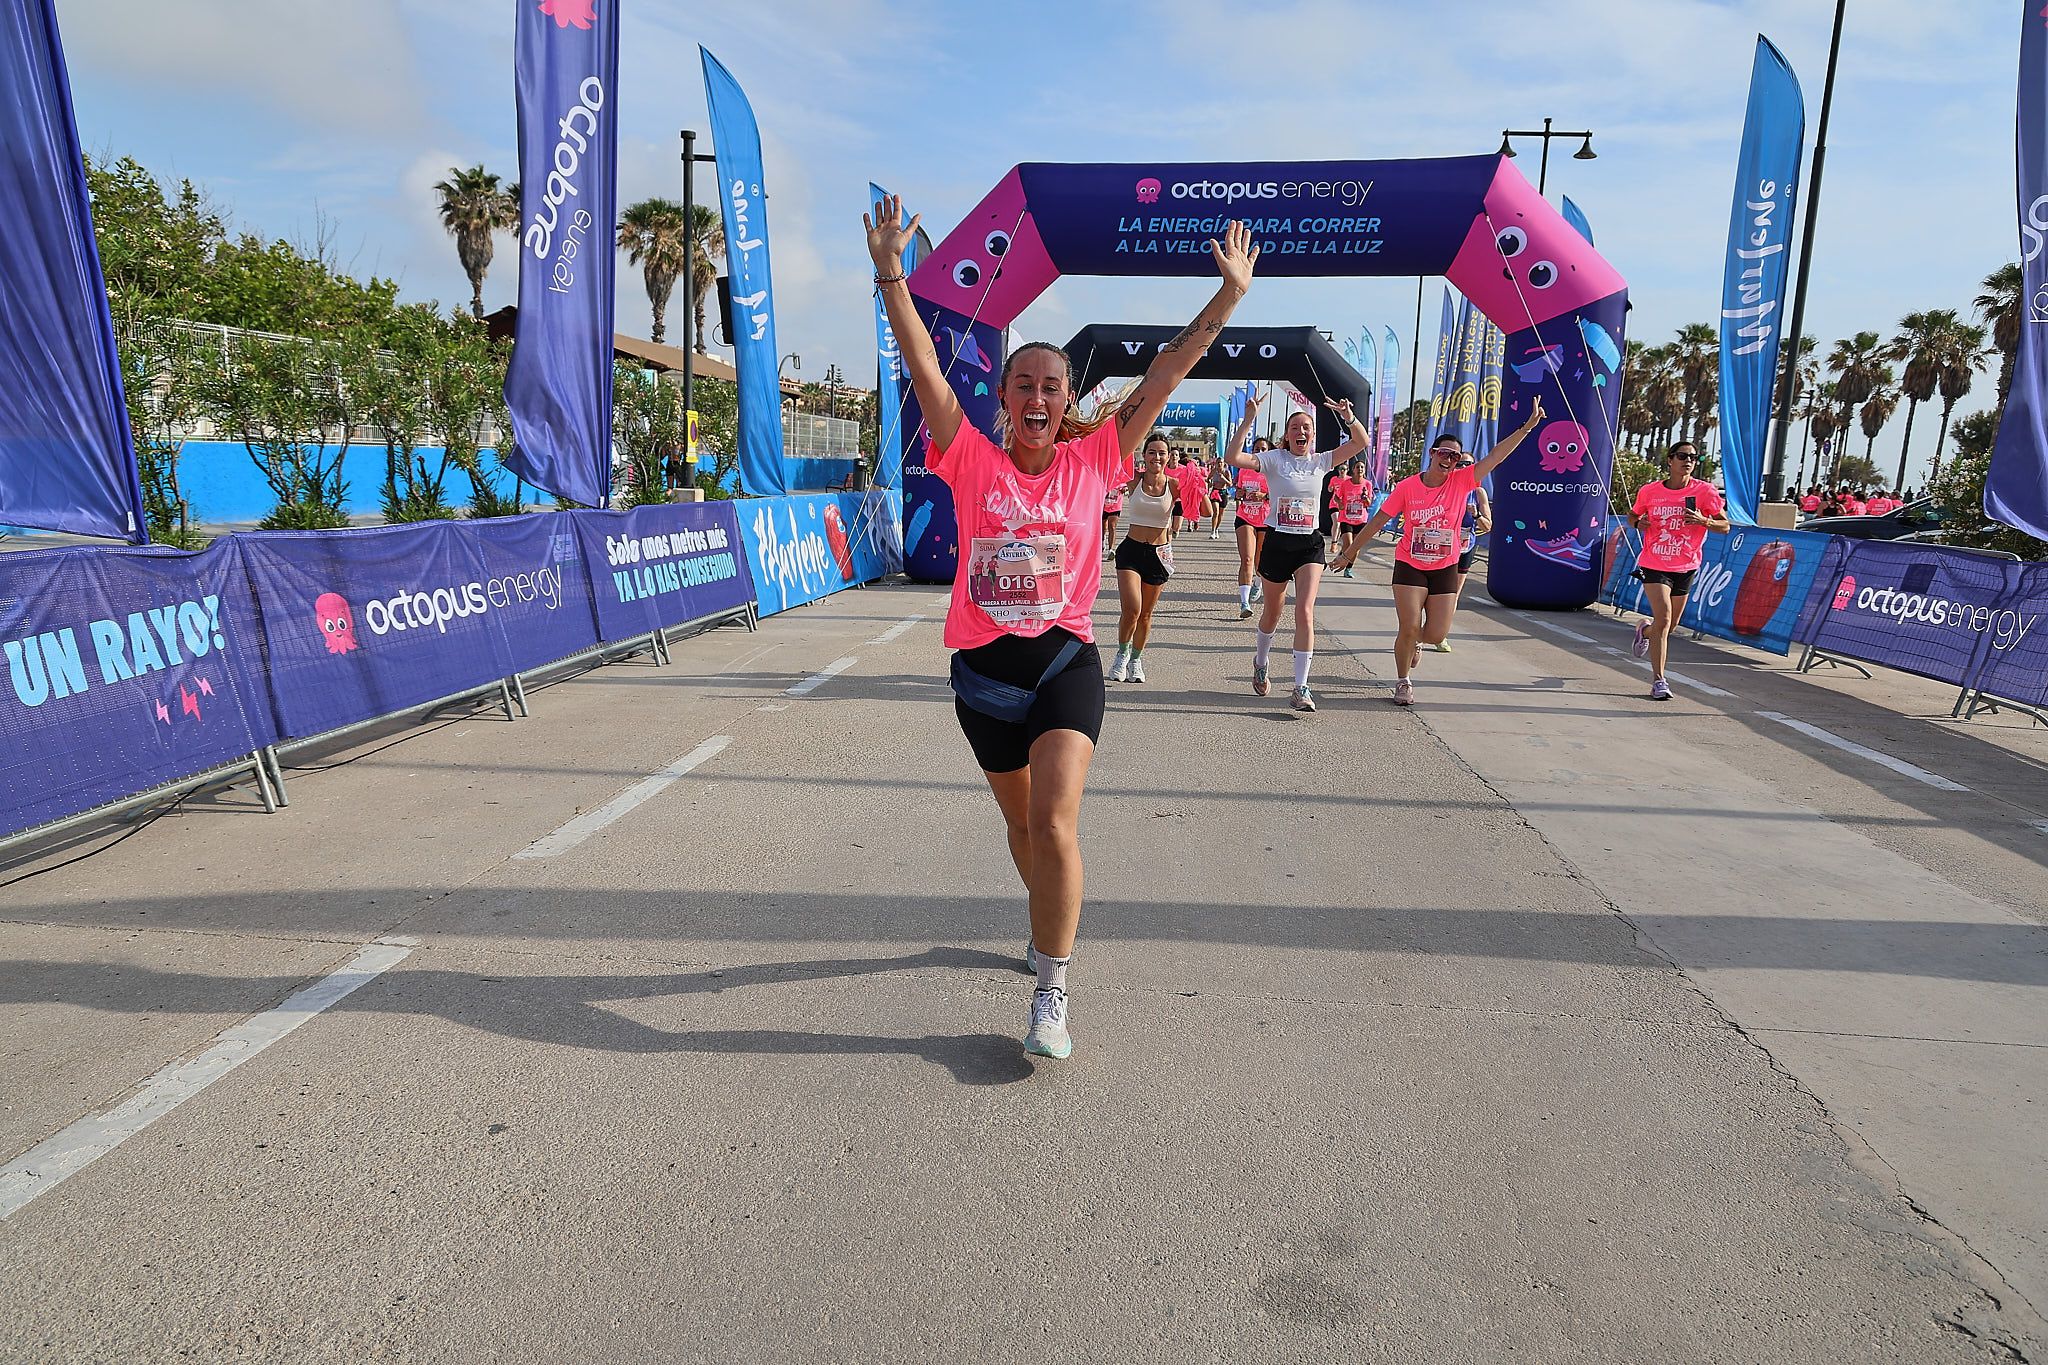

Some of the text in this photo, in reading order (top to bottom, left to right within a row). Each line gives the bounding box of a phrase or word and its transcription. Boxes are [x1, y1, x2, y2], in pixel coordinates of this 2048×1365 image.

[1171, 179, 1373, 206] octopus energy
[1118, 214, 1381, 233] LA ENERGÍA PARA CORRER
[1115, 240, 1384, 254] A LA VELOAD DE LA LUZ
[1121, 341, 1277, 359] VVO
[905, 465, 935, 477] octop
[1510, 480, 1604, 497] octopus energy
[1410, 504, 1446, 521] CARRERA
[606, 523, 728, 566] Solo unos metros más
[1652, 544, 1682, 556] MUJER
[753, 504, 829, 611] Marlene
[613, 552, 737, 602] YA LO HAS CONSEGUIDO
[999, 576, 1037, 590] 016
[365, 565, 562, 635] octopus energy
[1857, 586, 2037, 651] octopus energy
[4, 595, 226, 707] UN RAYO!
